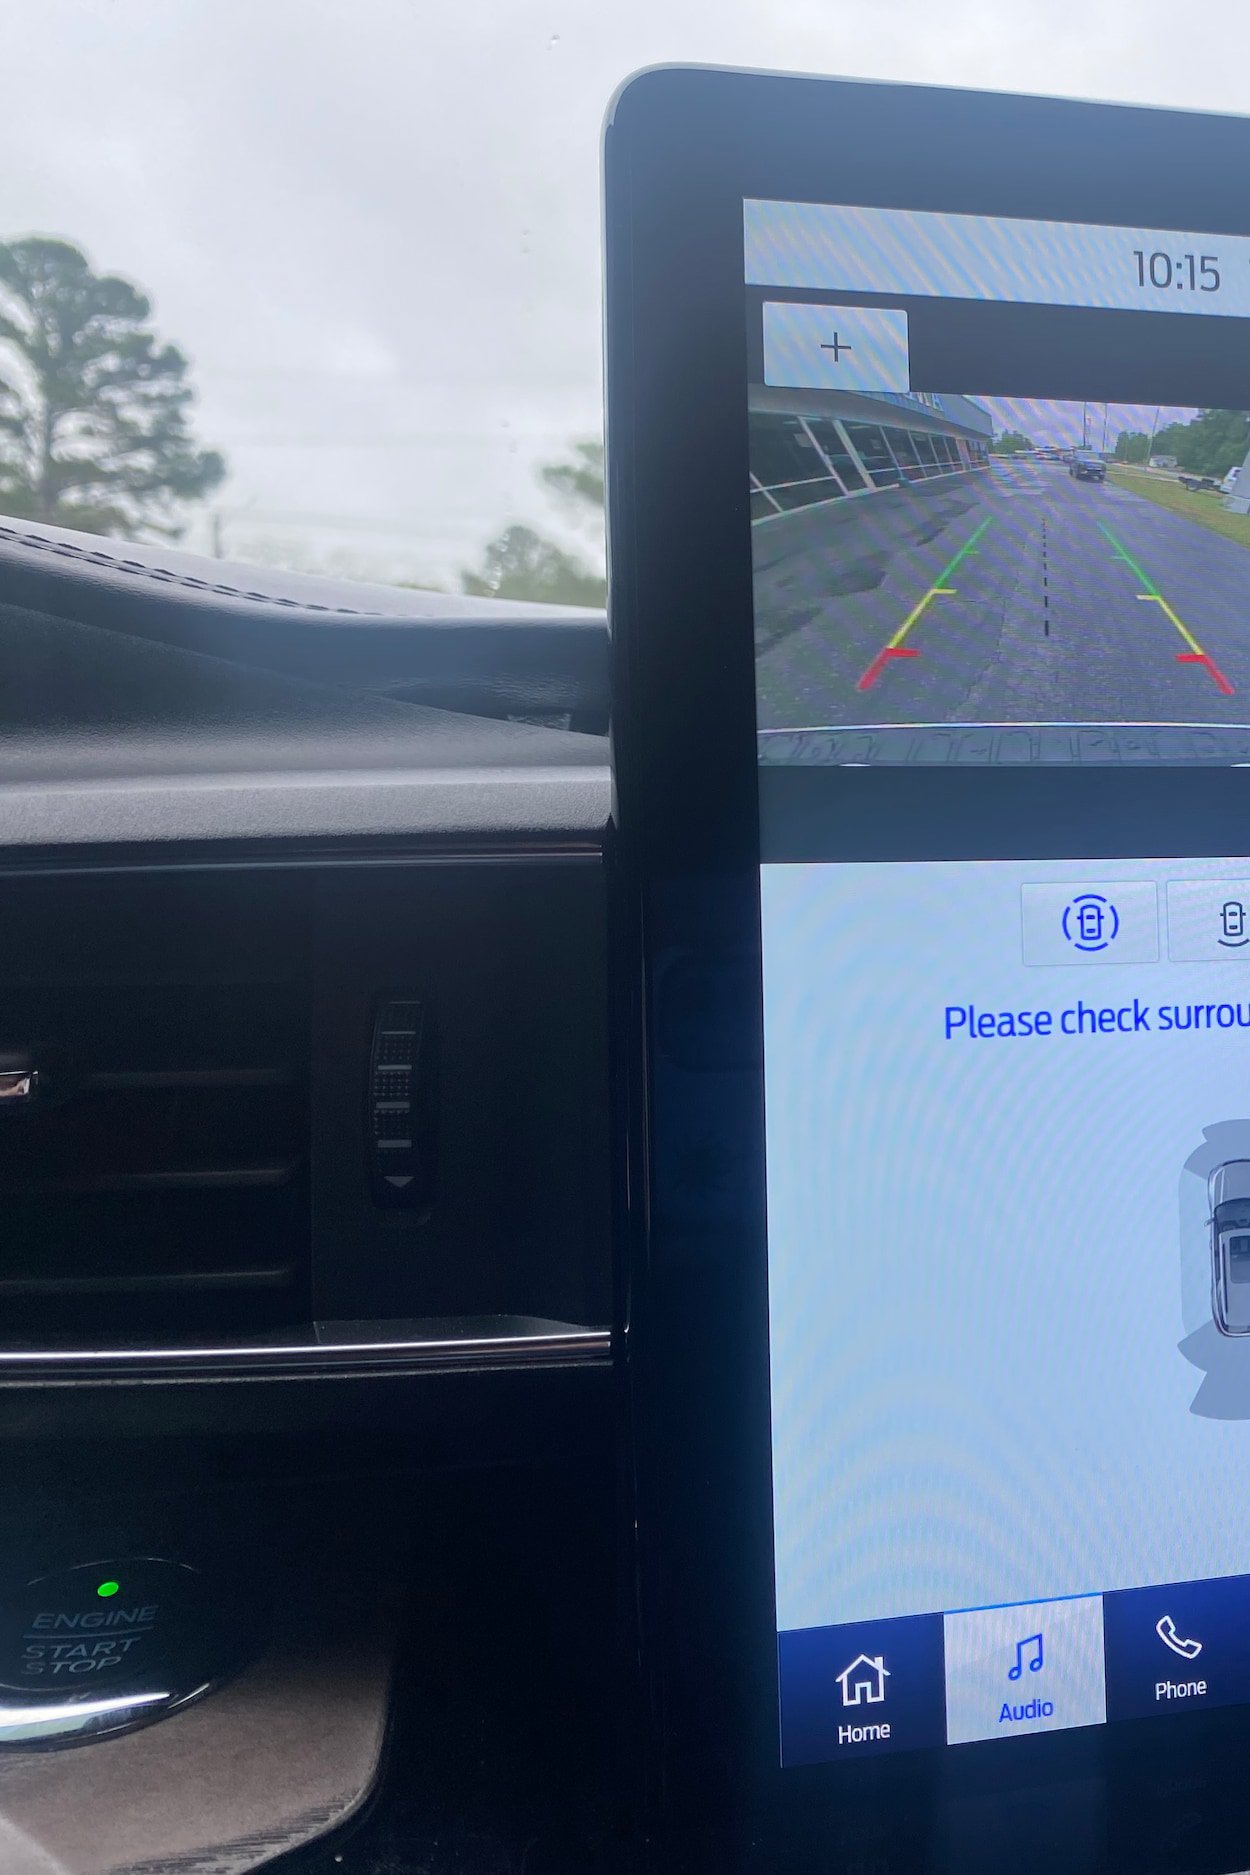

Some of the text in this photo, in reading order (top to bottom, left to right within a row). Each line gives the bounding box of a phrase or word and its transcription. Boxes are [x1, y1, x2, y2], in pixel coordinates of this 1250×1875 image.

[1133, 250, 1221, 292] 10:15
[944, 1003, 1052, 1040] Please
[1060, 998, 1150, 1035] check
[32, 1606, 158, 1630] ENGINE
[21, 1637, 142, 1659] START
[21, 1656, 122, 1675] STOP
[1154, 1679, 1207, 1701] Phone
[998, 1698, 1054, 1722] Audio
[838, 1722, 891, 1745] Home
